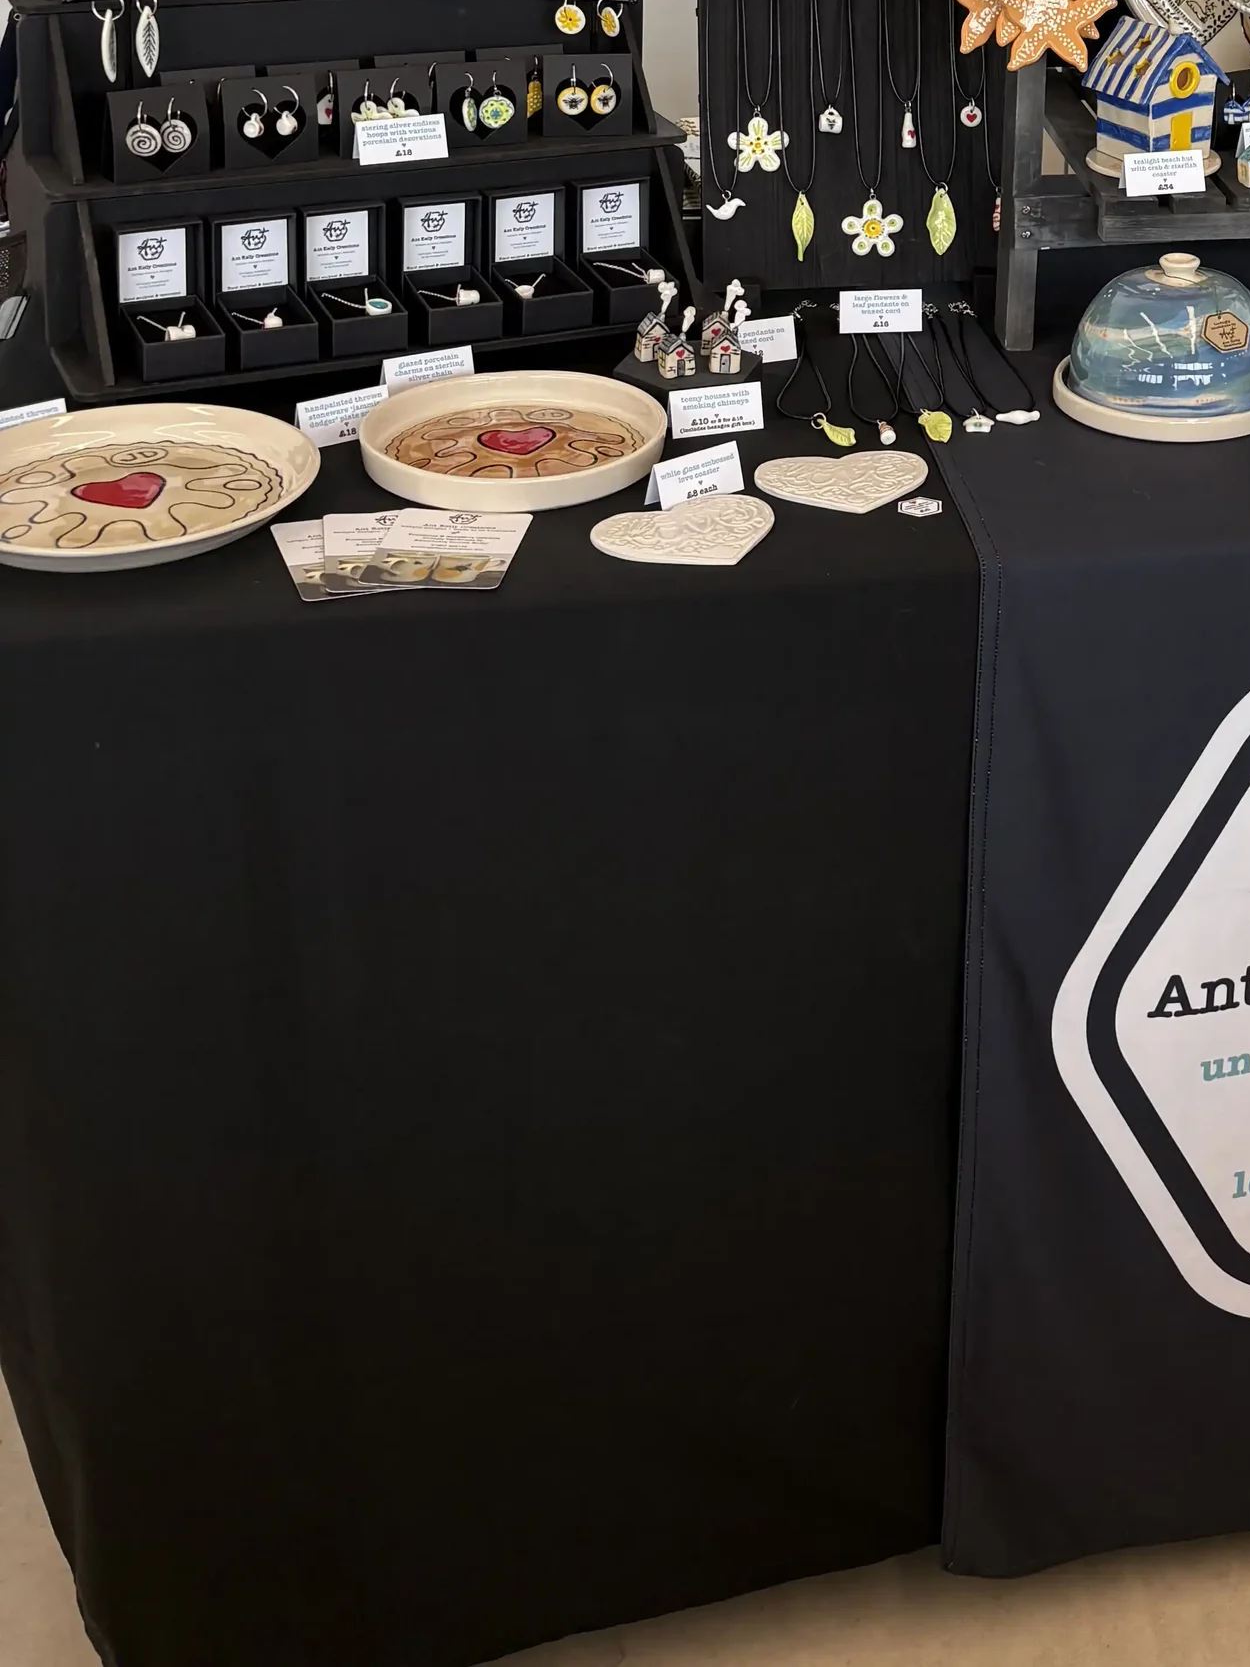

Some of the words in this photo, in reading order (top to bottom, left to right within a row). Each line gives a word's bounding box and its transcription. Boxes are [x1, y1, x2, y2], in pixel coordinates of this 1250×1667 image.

[363, 138, 397, 146] porcelain
[743, 330, 775, 338] pendants
[398, 361, 422, 369] glazed
[424, 354, 458, 365] porcelain
[395, 368, 423, 376] charms
[435, 360, 464, 369] sterling
[409, 374, 430, 382] silver
[305, 398, 353, 413] handpainted
[355, 392, 382, 403] thrown
[683, 402, 716, 410] smoking
[309, 407, 348, 420] stoneware
[340, 414, 359, 422] plate
[691, 418, 709, 426] £10
[339, 428, 357, 437] £18
[120, 450, 158, 462] JD
[661, 470, 680, 480] white
[682, 464, 699, 475] gloss
[701, 453, 734, 468] embossed
[678, 475, 693, 483] love
[695, 467, 720, 478] coaster
[687, 489, 698, 499] £8
[700, 484, 718, 494] each
